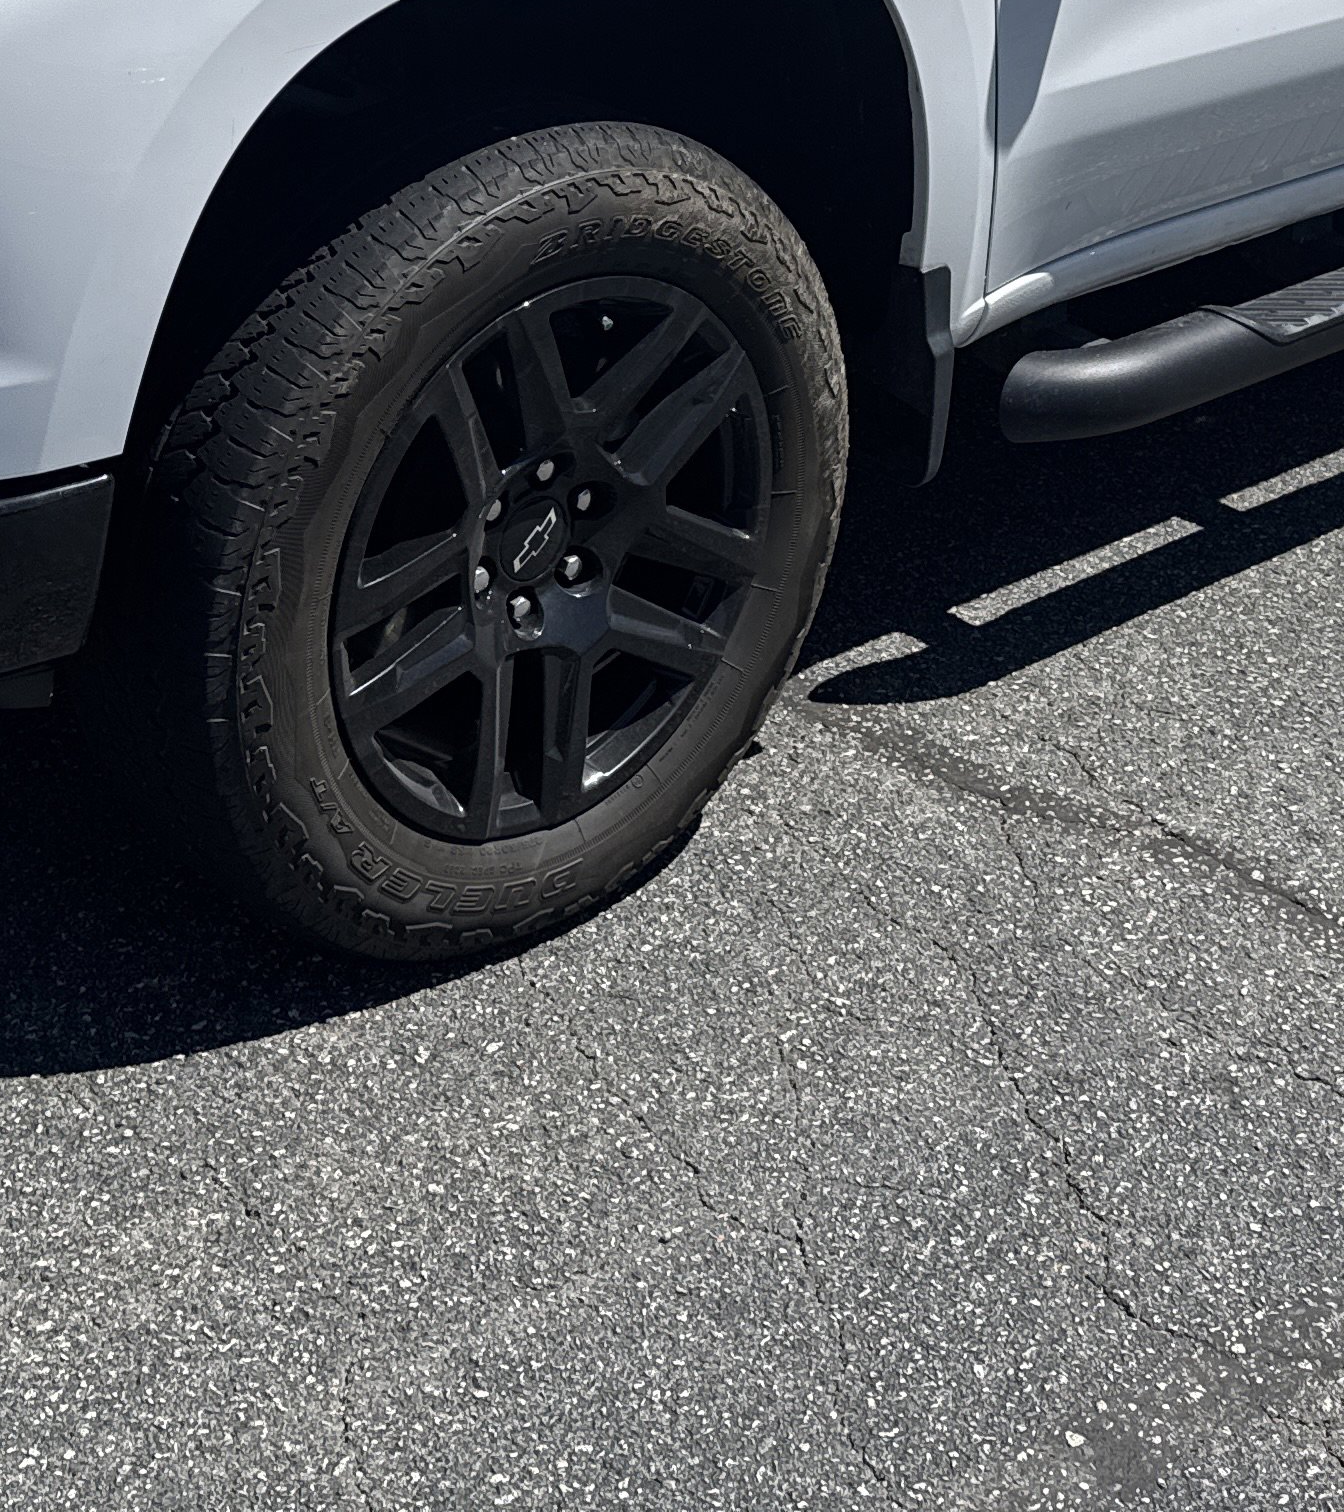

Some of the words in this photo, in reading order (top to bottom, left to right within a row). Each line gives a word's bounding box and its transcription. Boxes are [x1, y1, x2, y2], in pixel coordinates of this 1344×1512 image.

[529, 214, 802, 339] BRIDGESTONE
[309, 777, 354, 833] A/T
[350, 840, 585, 913] DUELER
